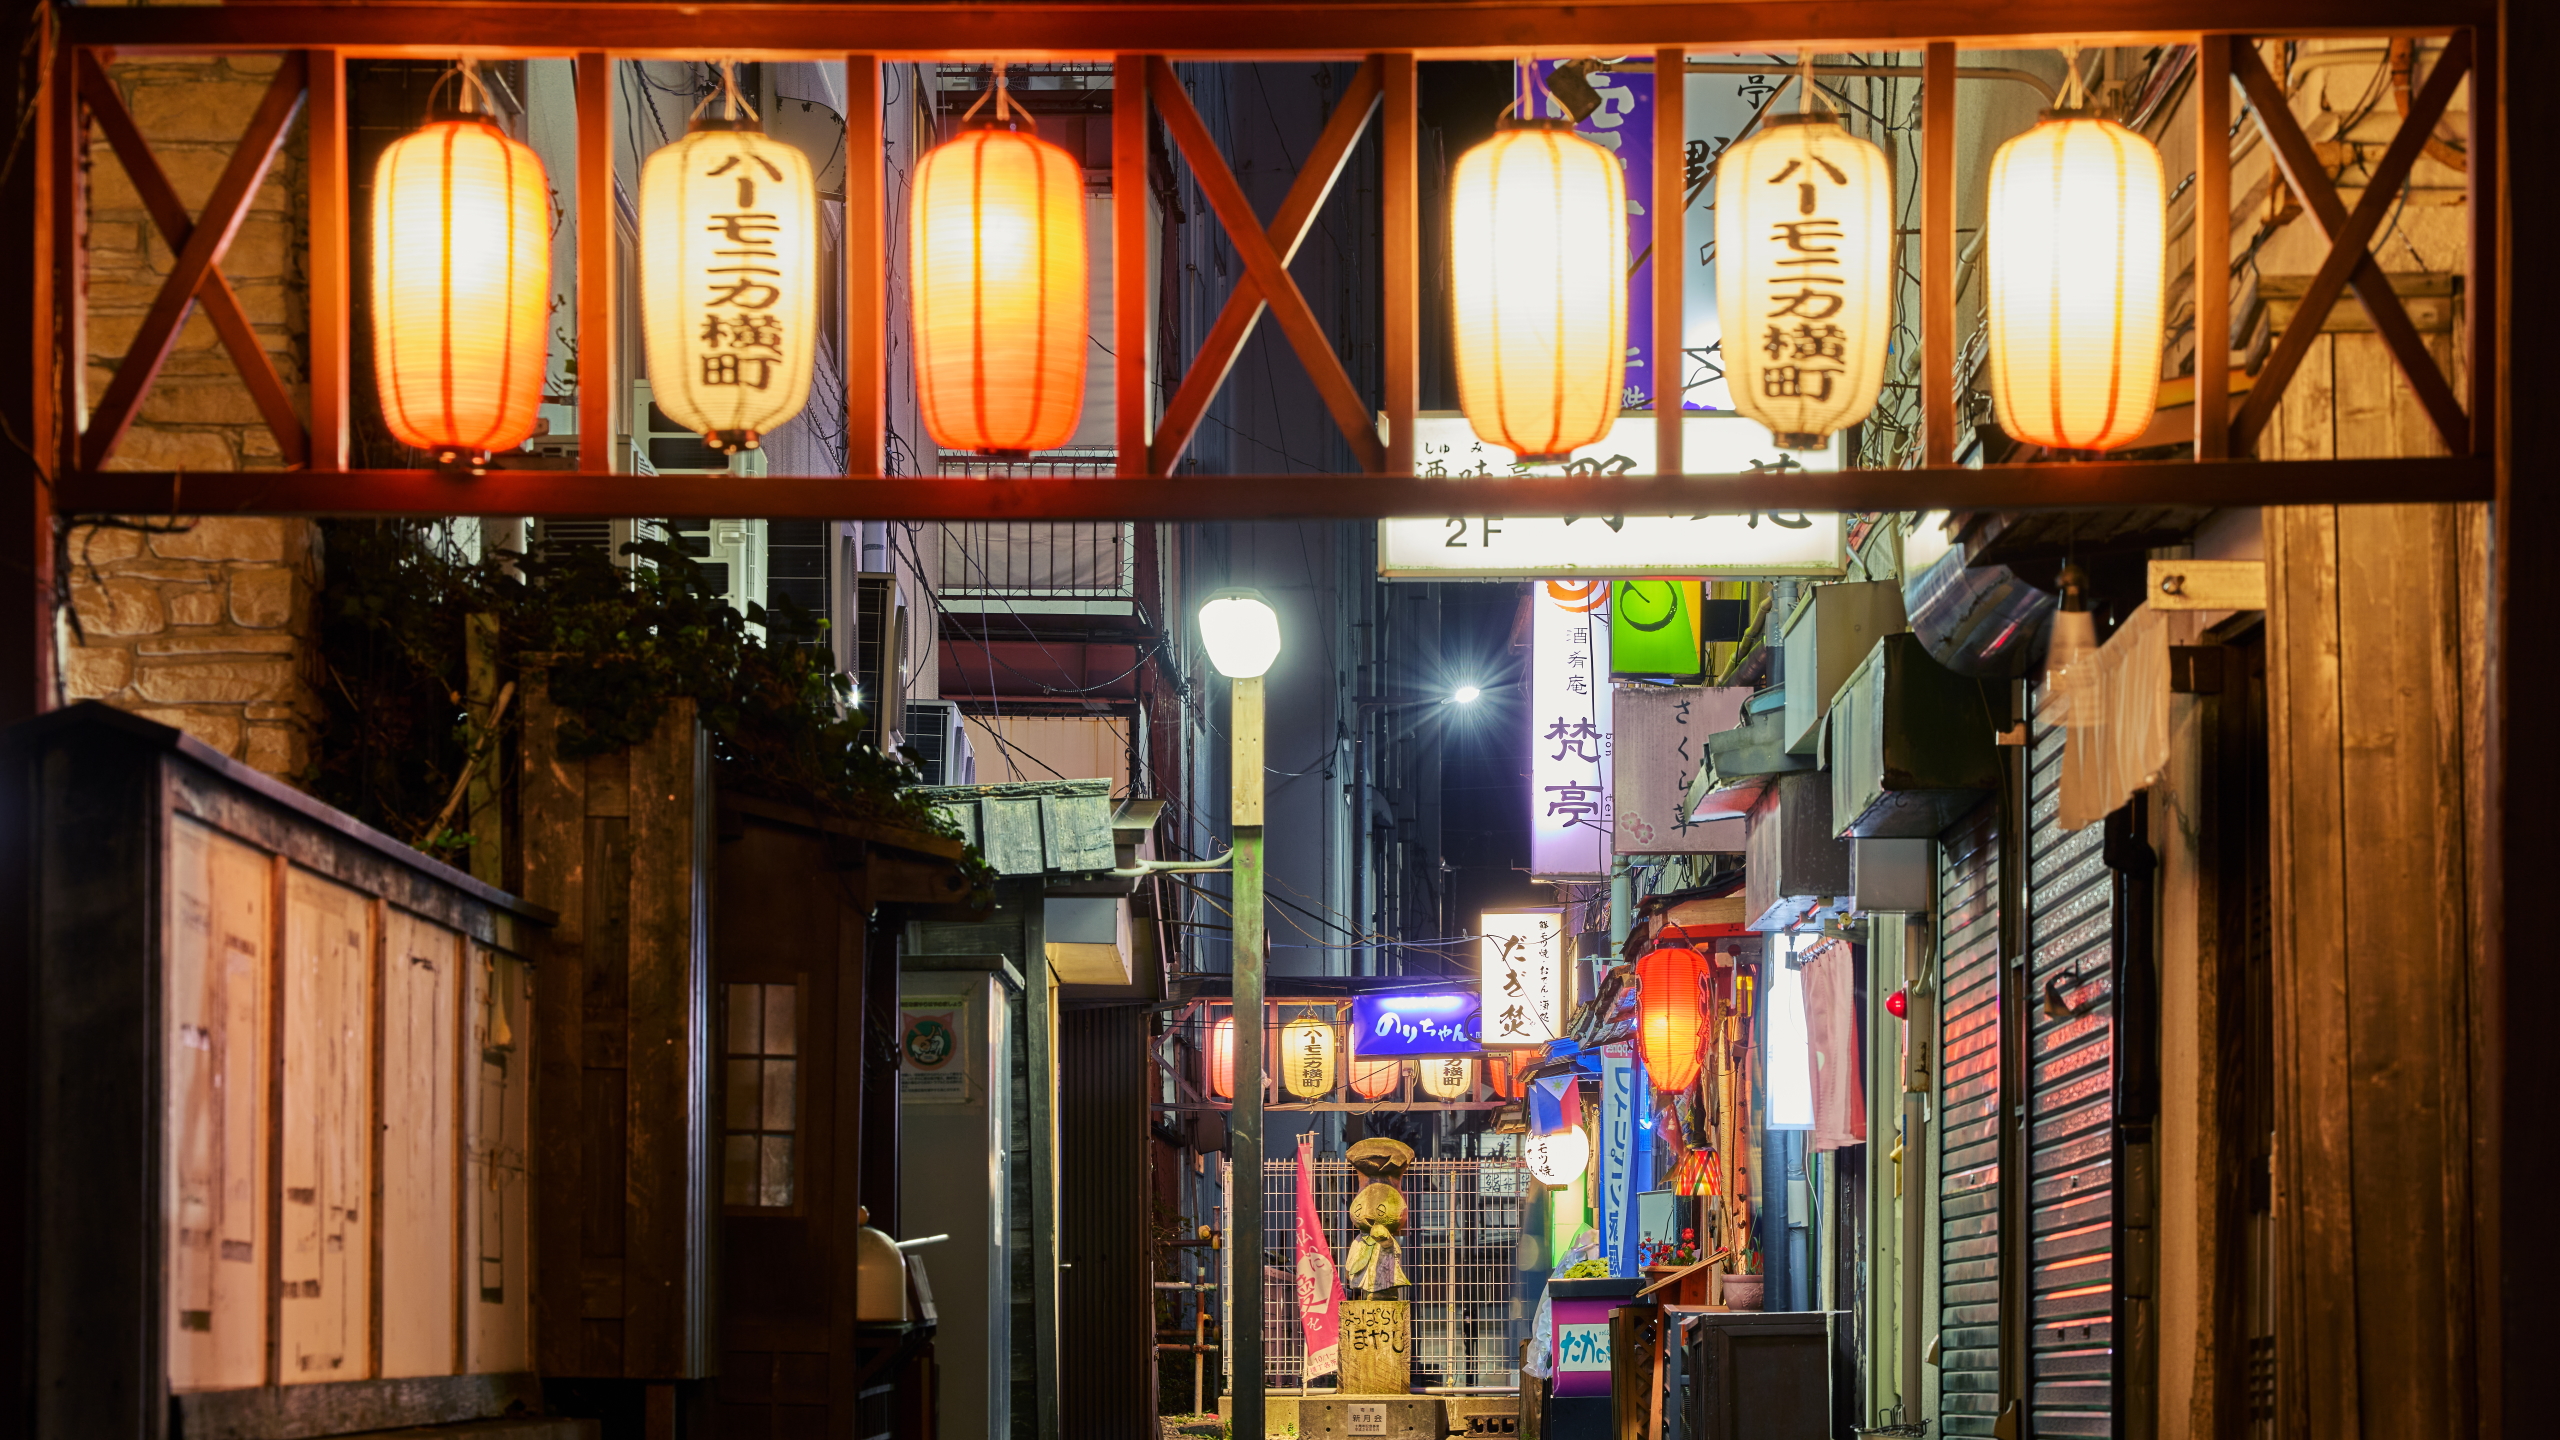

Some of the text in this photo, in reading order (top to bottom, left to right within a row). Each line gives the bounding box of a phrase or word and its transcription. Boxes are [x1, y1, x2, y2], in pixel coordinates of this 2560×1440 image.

[701, 155, 783, 390] ハーモニカ横町
[1763, 153, 1847, 401] ハーモニカ横町
[1445, 515, 1504, 547] 2F
[1567, 627, 1588, 695] 酒肴庵
[1544, 716, 1603, 828] 梵亭
[1375, 1012, 1469, 1044] のりちゃん
[1302, 1029, 1323, 1088] ハーモニカ横町
[1538, 1134, 1554, 1176] モツ焼
[1560, 1330, 1610, 1364] たかの
